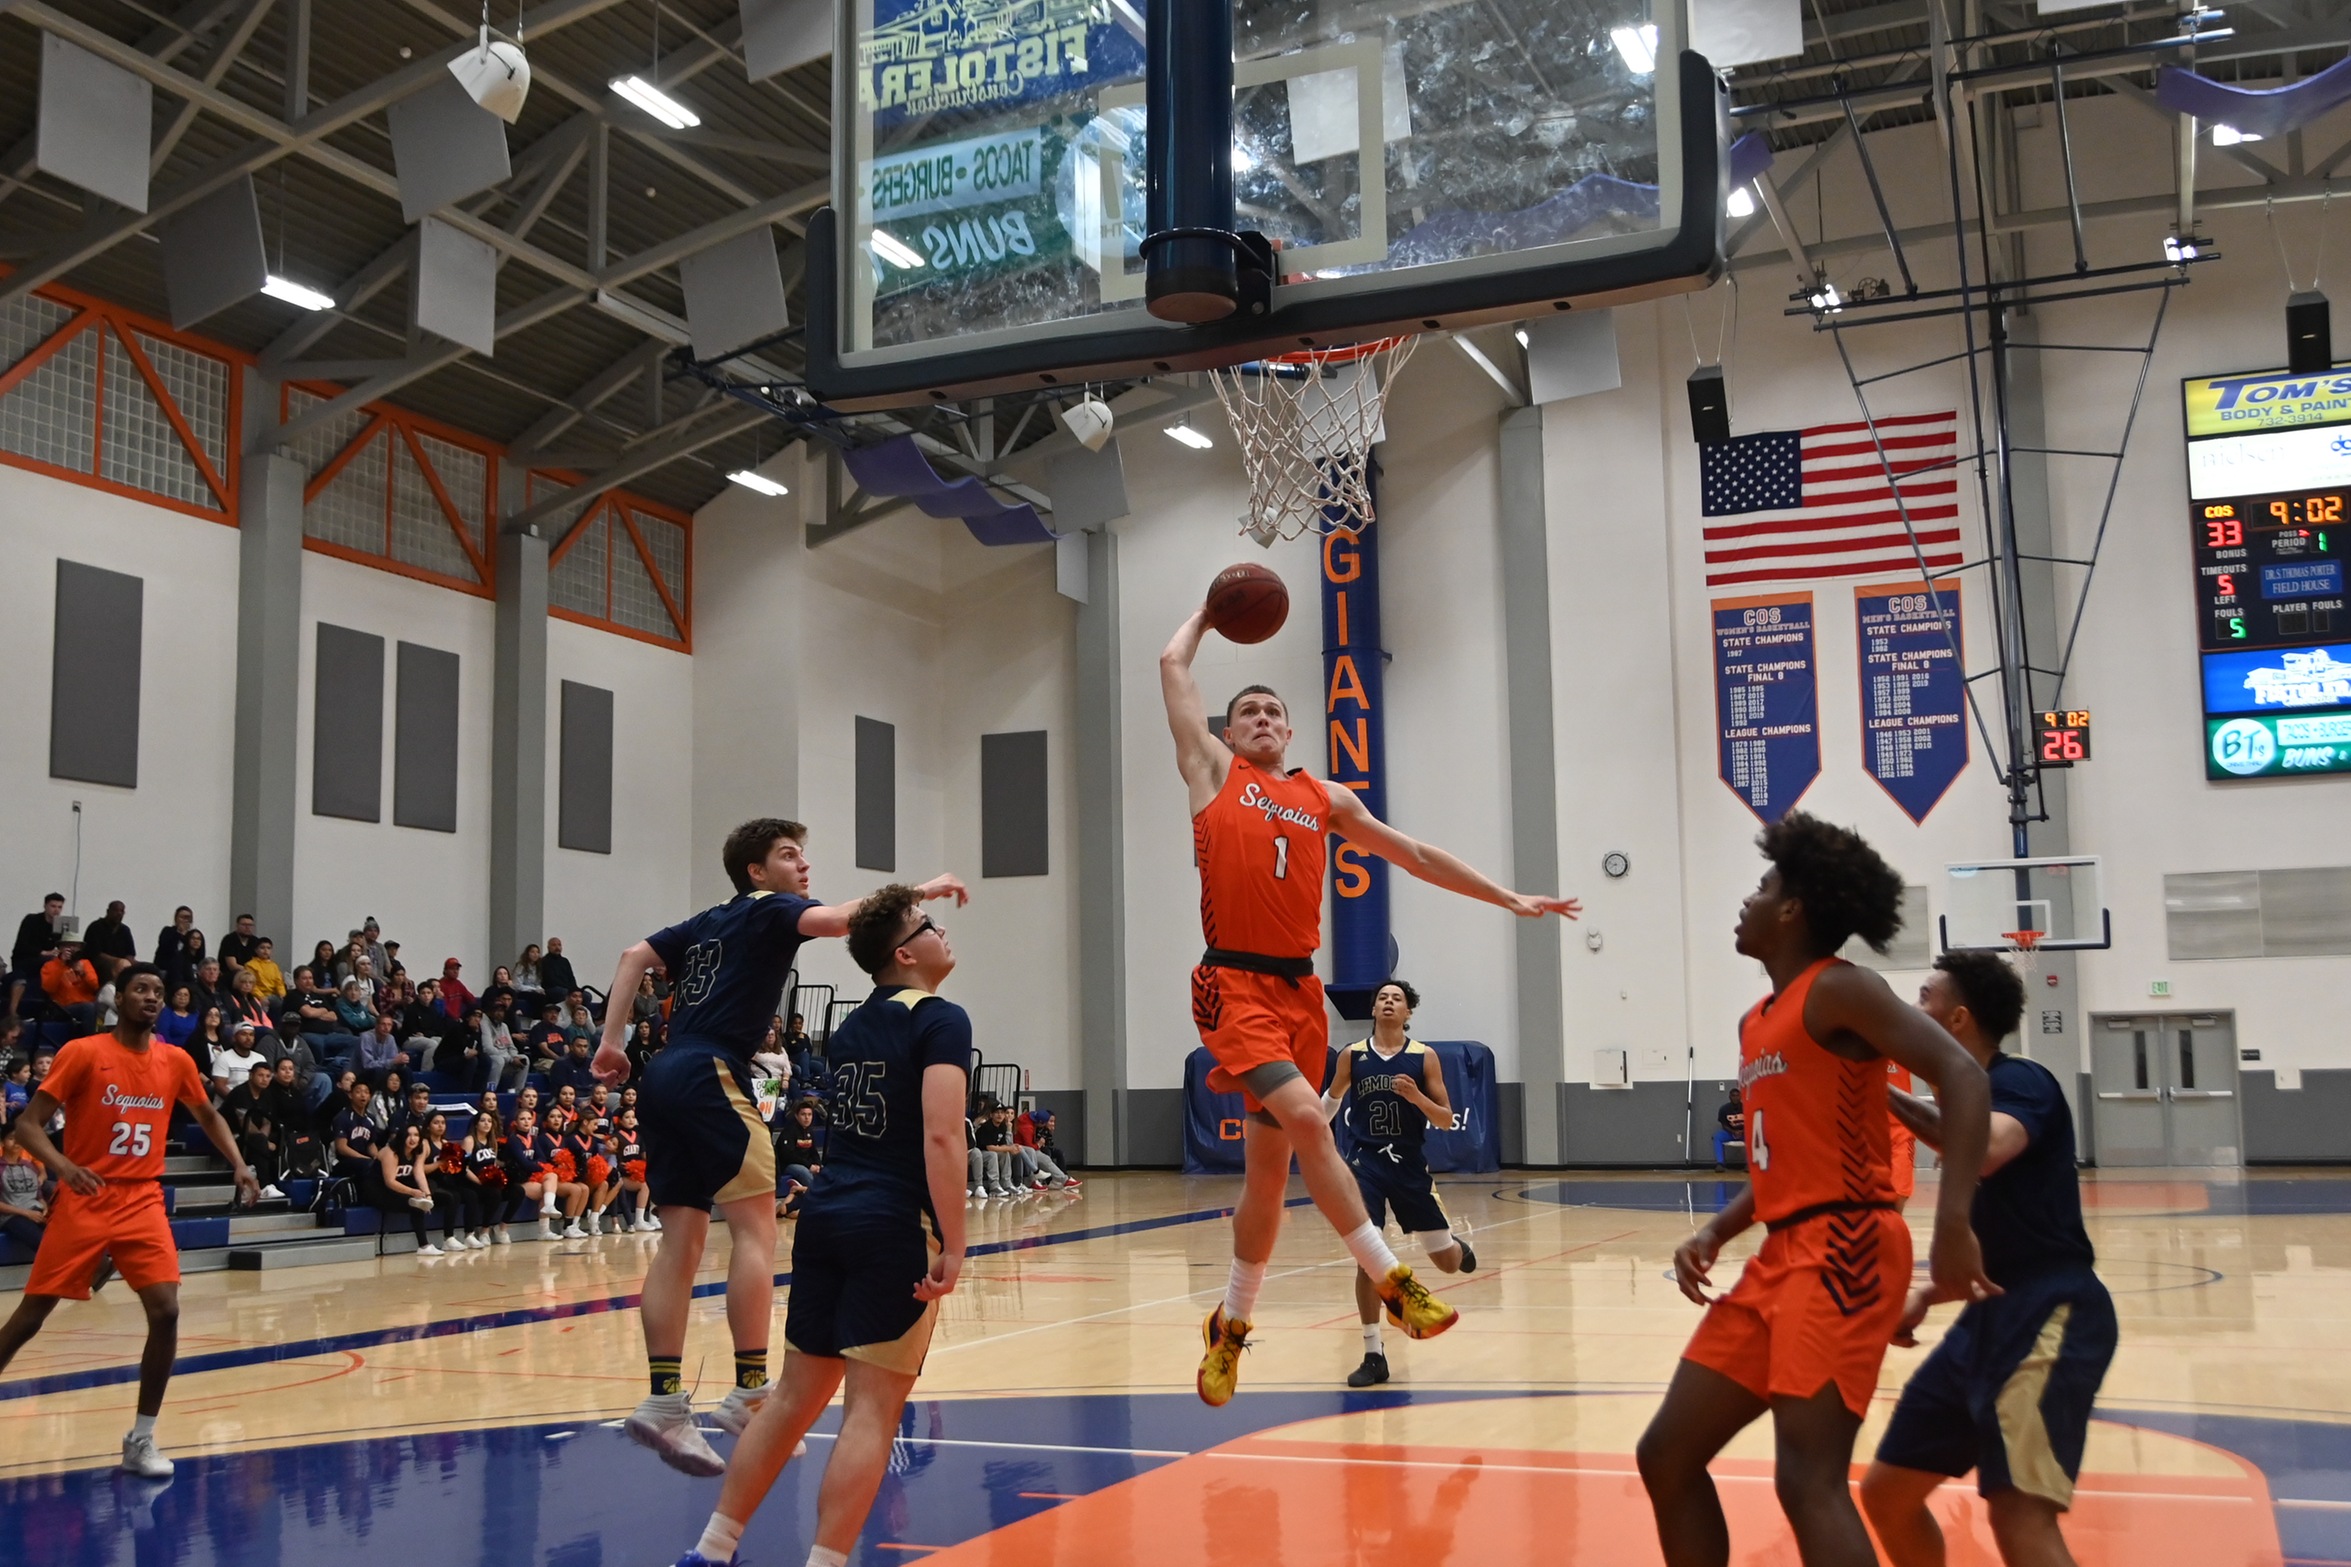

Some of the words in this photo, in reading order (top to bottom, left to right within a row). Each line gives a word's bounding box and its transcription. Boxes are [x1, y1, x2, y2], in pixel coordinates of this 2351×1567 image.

[2208, 377, 2351, 411] TOM'S
[2220, 406, 2273, 421] BODY
[2280, 404, 2294, 415] &
[2257, 412, 2323, 427] 732-3914
[2204, 504, 2235, 518] COS
[2270, 496, 2343, 525] 9:02
[2206, 520, 2243, 547] 33
[2271, 537, 2306, 548] PERIOD
[2317, 532, 2328, 552] 1
[2216, 549, 2247, 559] BONUS
[2201, 564, 2247, 575] TIMEOUTS
[2282, 567, 2309, 578] THOMAS
[2310, 564, 2336, 576] PORTER
[2217, 574, 2235, 595] 5
[2272, 582, 2299, 594] FIELD
[2301, 579, 2331, 592] HOUSE
[1888, 595, 1927, 614] COS
[2214, 595, 2236, 605] LEFT
[2272, 602, 2308, 613] PLAYER
[2312, 600, 2343, 610] FOULS
[1744, 608, 1781, 626] COS
[2214, 608, 2244, 618] FOULS
[1756, 621, 1810, 633] BASKETBALL
[1867, 625, 1896, 635] STATE
[2229, 617, 2247, 639] 5
[1723, 637, 1751, 647] STATE
[1755, 632, 1804, 645] CHAMPIONS
[1868, 652, 1898, 663] STATE
[1901, 649, 1953, 661] CHAMPIONS
[1725, 664, 1753, 675] STATE
[1757, 660, 1806, 672] CHAMPIONS
[1891, 661, 1919, 671] FINAL
[1747, 672, 1773, 683] FINAL
[1323, 528, 1371, 898] GIANS
[1869, 717, 1903, 729] LEAGUE
[1907, 714, 1959, 726] CHAMPIONS
[1725, 727, 1758, 738] LEAGUE
[1762, 724, 1811, 736] CHAMPIONS
[2043, 730, 2084, 760] 26
[2281, 746, 2335, 769] BUNS
[1239, 783, 1319, 831] Sequoias
[1273, 836, 1289, 880] 1
[1357, 1074, 1395, 1096] LEMO
[102, 1084, 165, 1114] Sequoias
[833, 1061, 887, 1139] 35
[1369, 1100, 1402, 1136] 21
[109, 1121, 153, 1157] 25
[351, 1126, 371, 1140] GIANTS
[1752, 1109, 1770, 1171] 4
